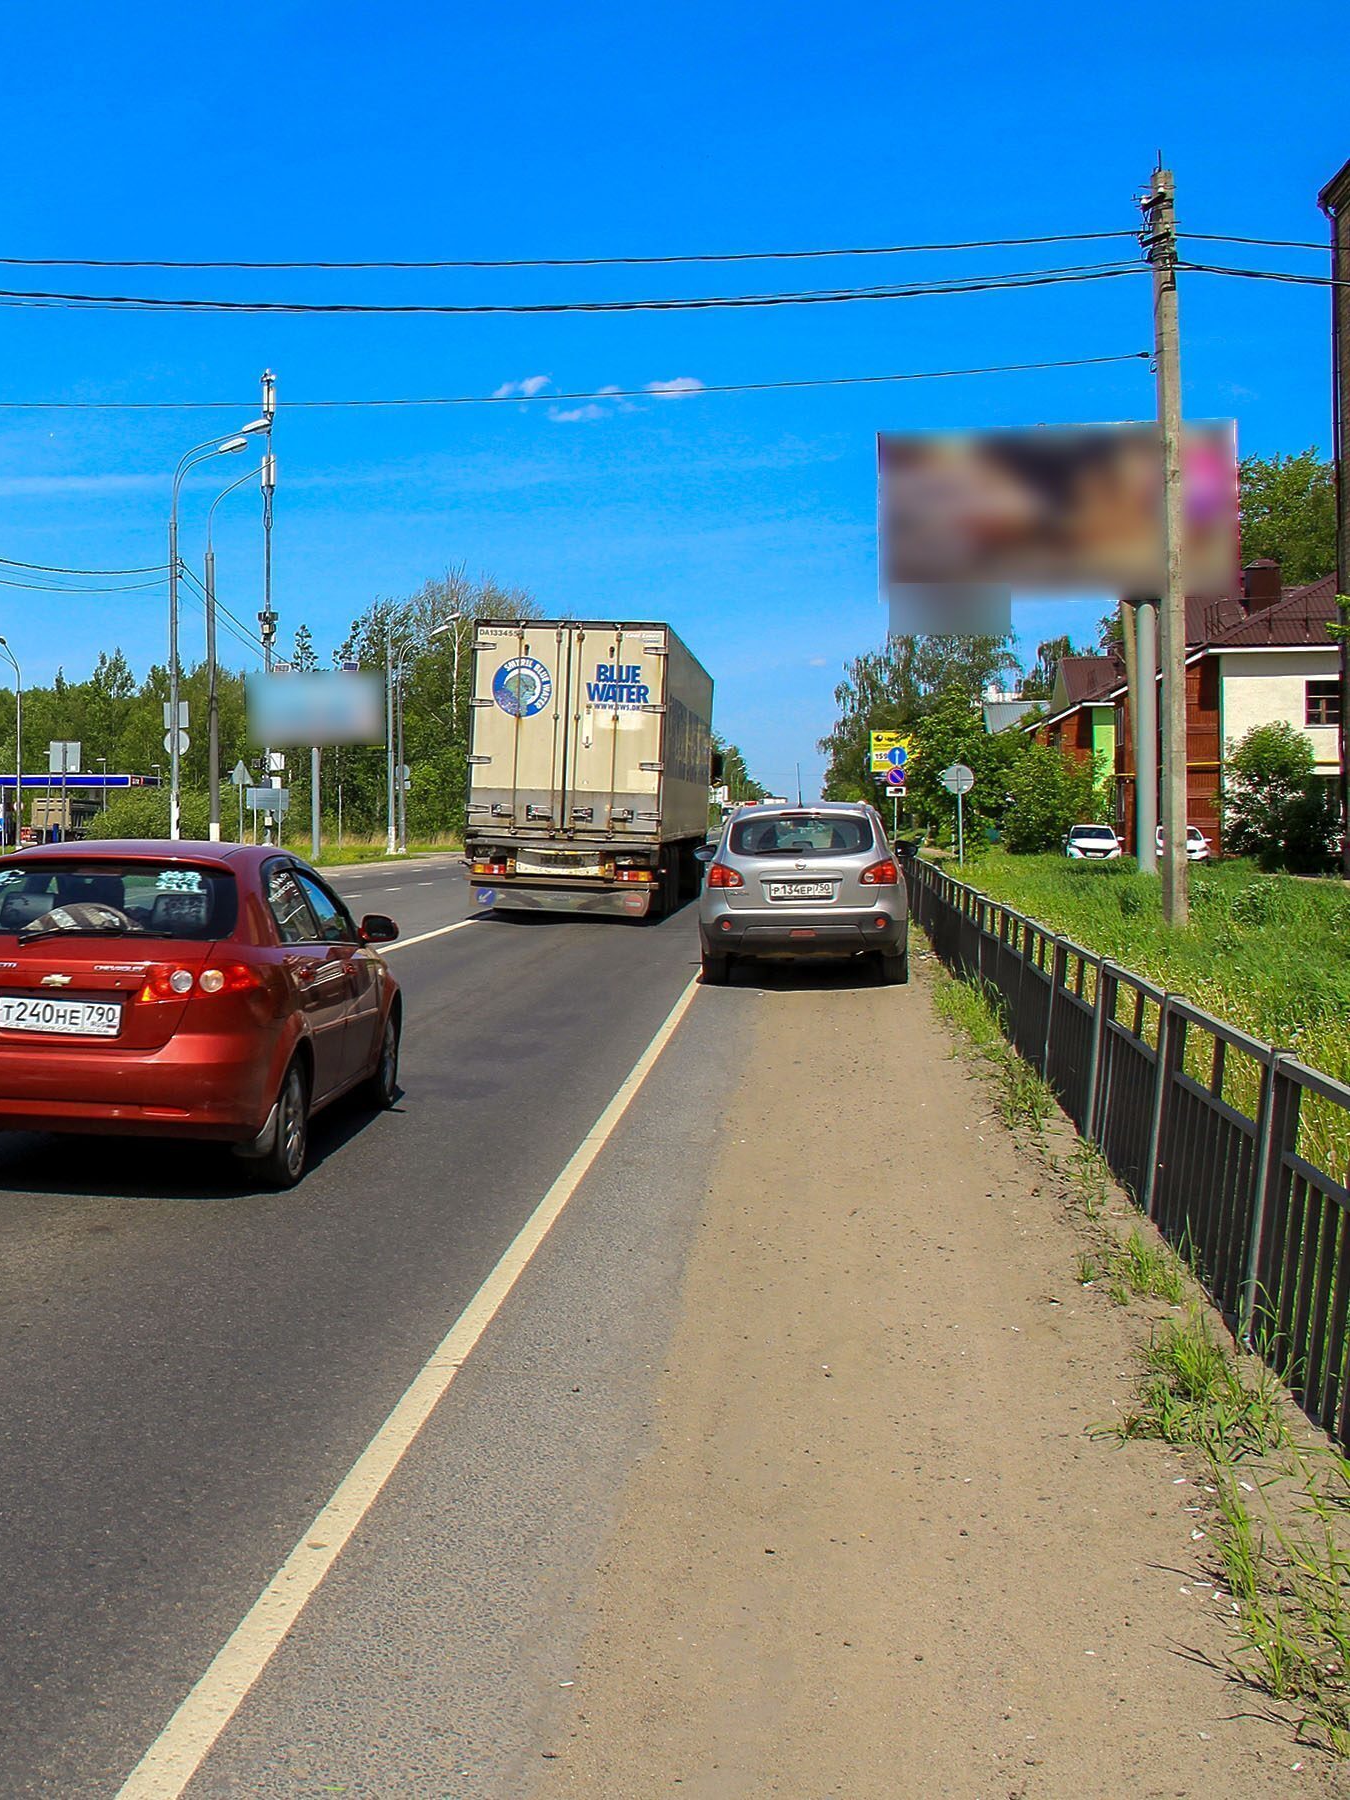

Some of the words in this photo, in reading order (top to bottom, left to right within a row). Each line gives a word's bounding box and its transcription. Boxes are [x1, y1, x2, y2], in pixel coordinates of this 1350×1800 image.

[533, 663, 549, 682] BLUE
[596, 664, 641, 683] BLUE
[535, 683, 551, 709] WATER
[586, 682, 649, 703] WATER
[85, 1005, 117, 1023] 790
